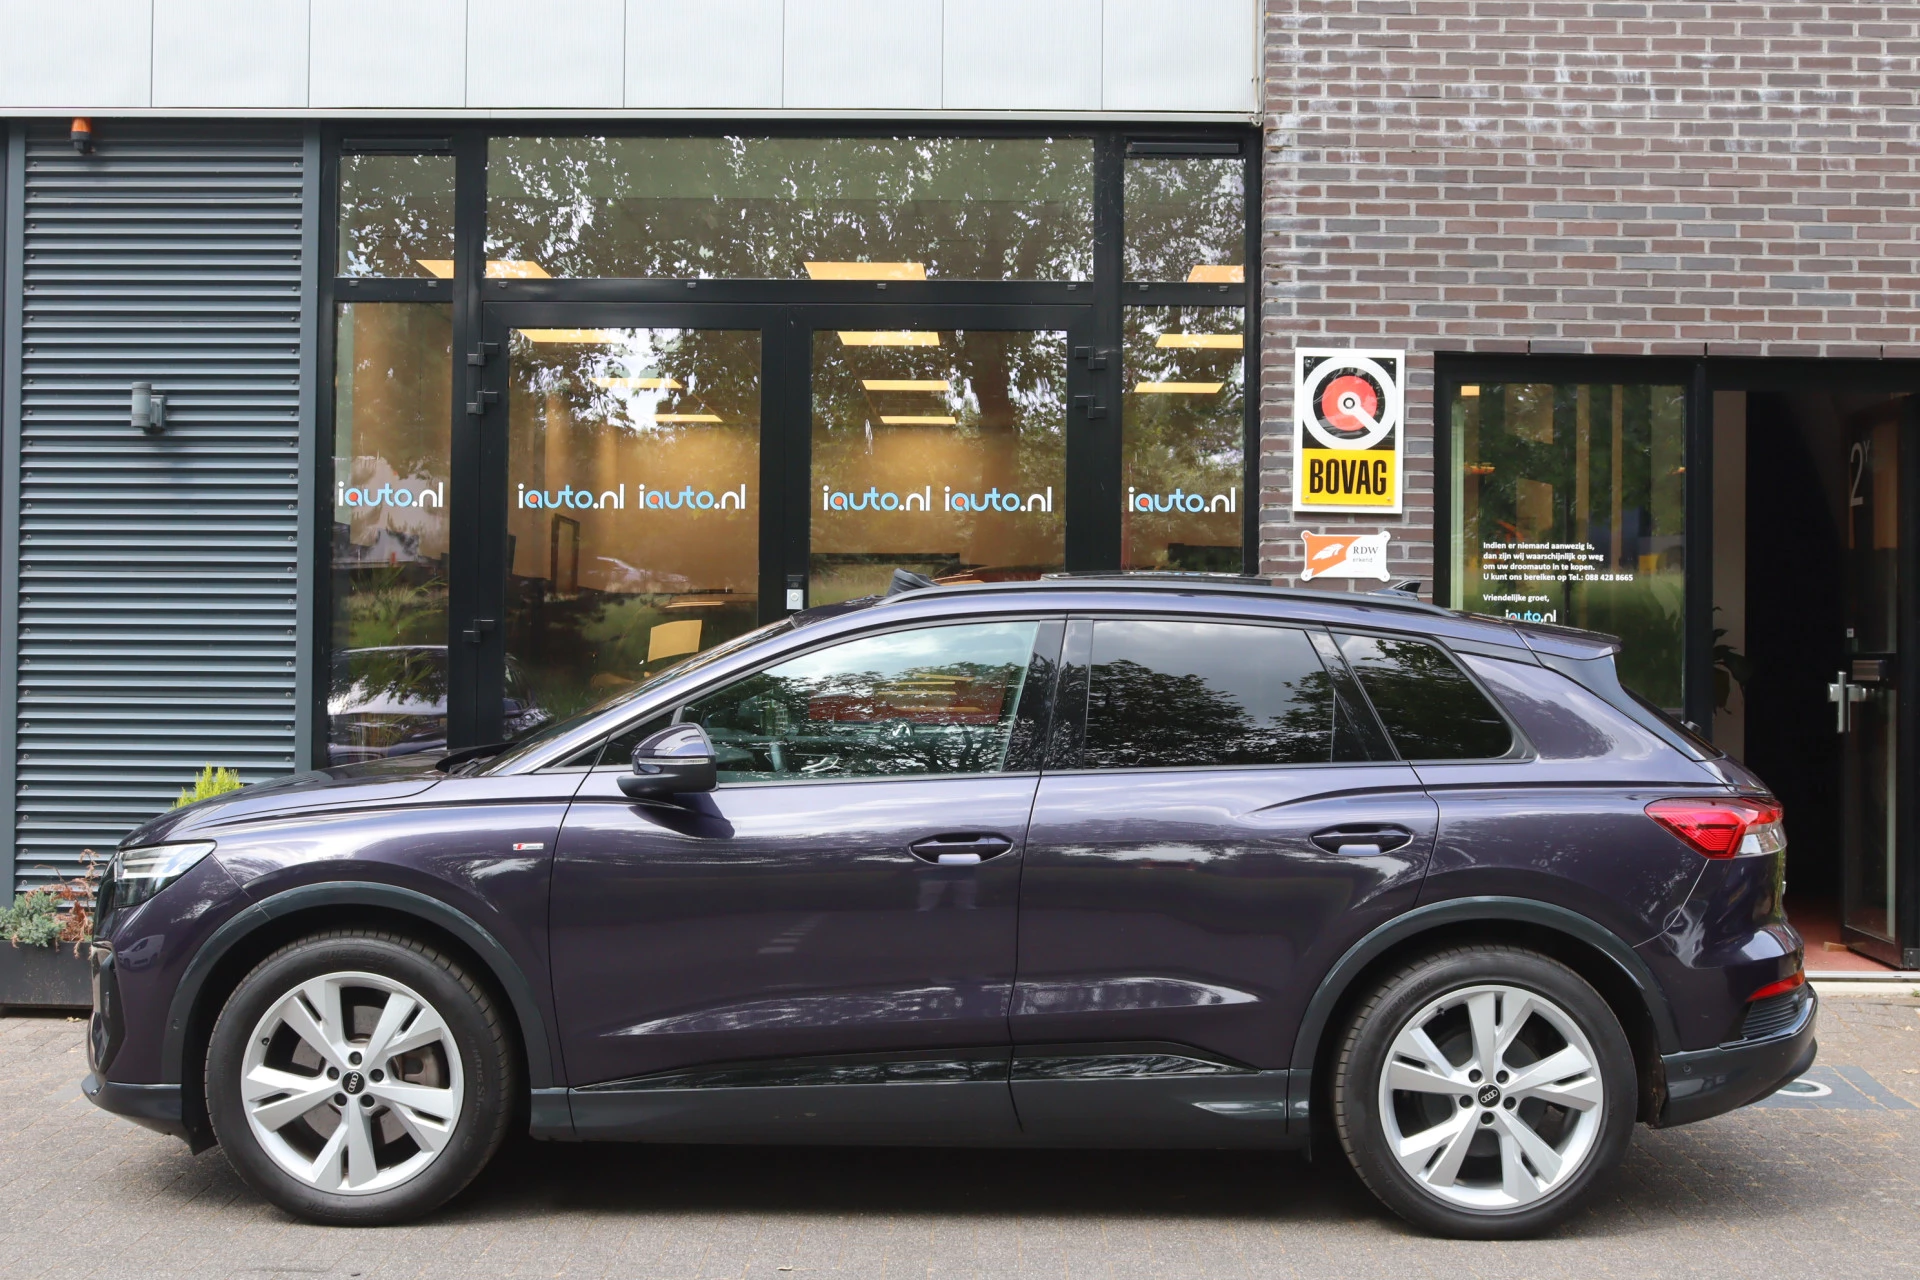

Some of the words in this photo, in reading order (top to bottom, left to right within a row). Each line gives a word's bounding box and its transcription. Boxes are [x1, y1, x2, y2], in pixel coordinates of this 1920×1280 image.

[1309, 458, 1387, 496] BOVAG
[338, 481, 444, 508] iauto.nl
[518, 483, 625, 510] iauto.nl
[639, 483, 746, 510] iauto.nl
[823, 485, 931, 512] iauto.nl
[944, 485, 1052, 512] iauto.nl
[1128, 486, 1236, 513] iauto.nl
[1353, 546, 1379, 555] RDW
[1483, 542, 1507, 550] Indien
[1517, 542, 1550, 550] niemand
[1551, 542, 1585, 551] aanwezig
[1586, 542, 1595, 551] is,
[1483, 552, 1497, 560] dan
[1498, 552, 1512, 561] zijn
[1513, 552, 1525, 561] wij
[1526, 552, 1576, 561] waarschijnlijk
[1577, 554, 1587, 562] op
[1588, 554, 1604, 562] weg
[1491, 573, 1508, 581] kunt
[1523, 573, 1556, 581] bereiken
[1557, 575, 1567, 583] op
[1585, 573, 1599, 581] 088
[1600, 573, 1614, 581] 428
[1615, 574, 1634, 582] 8665
[1570, 563, 1595, 572] kopen.
[1483, 594, 1527, 603] Vriendelijke
[1528, 595, 1550, 603] groet,
